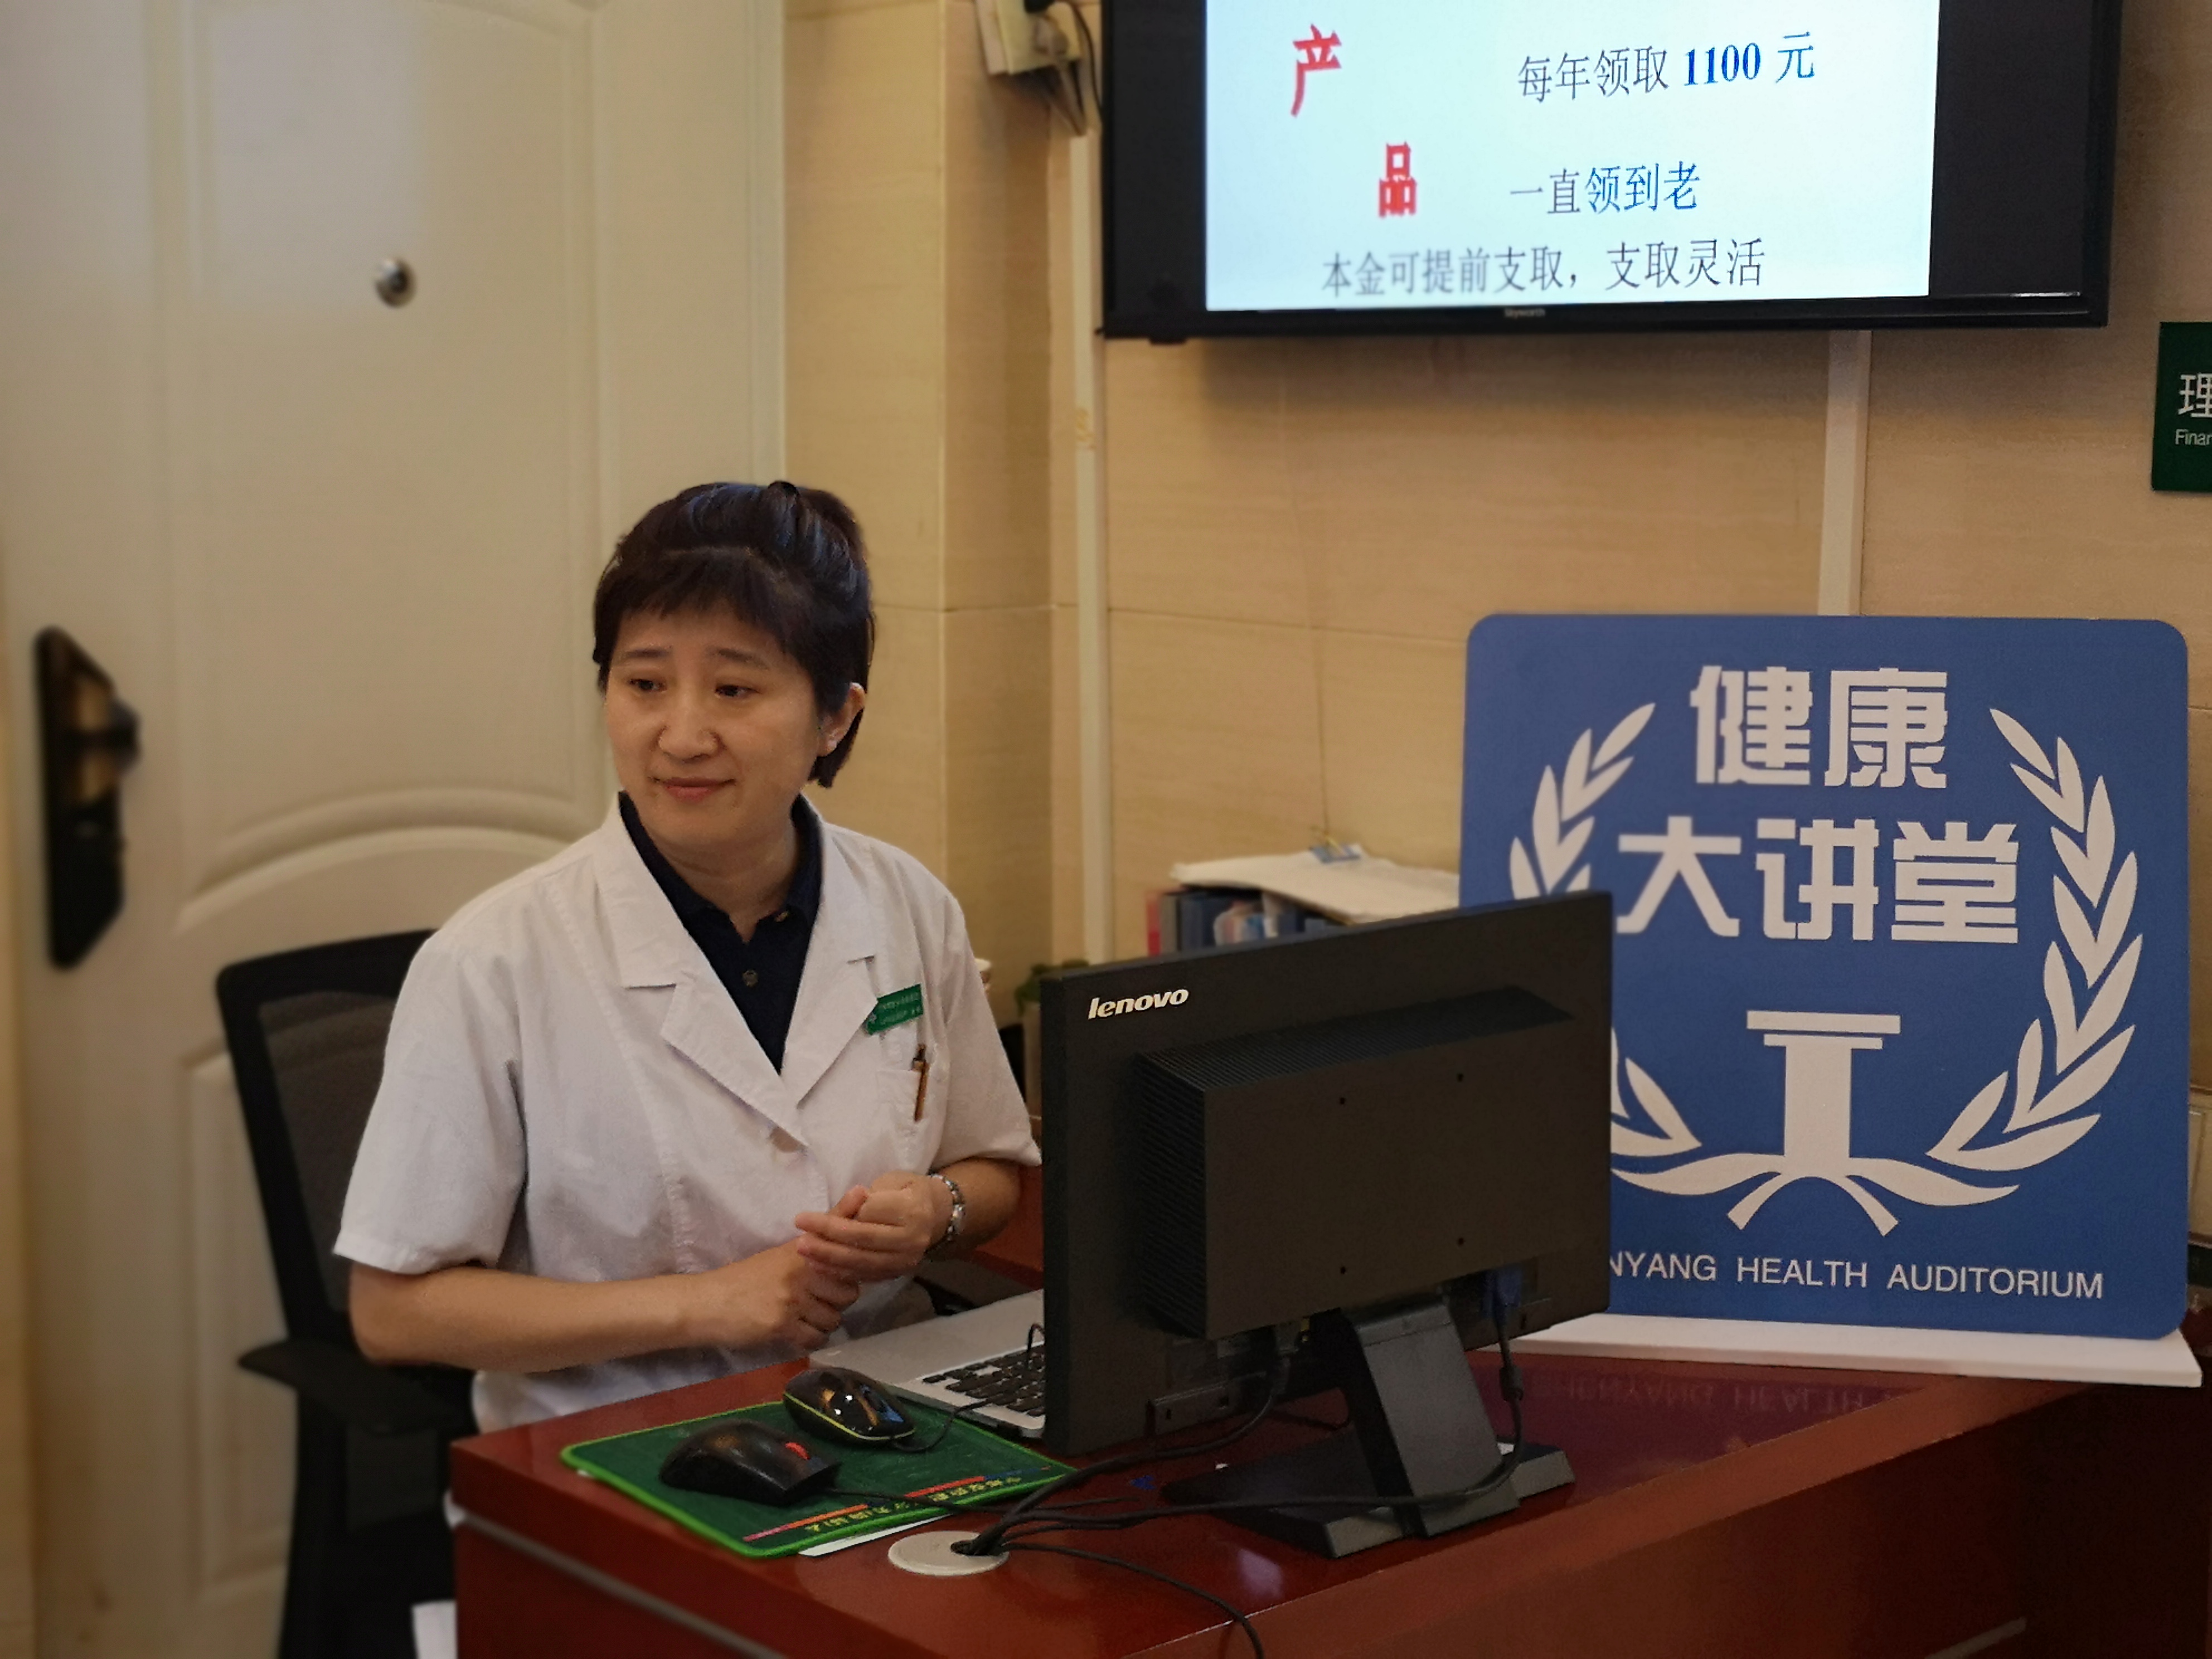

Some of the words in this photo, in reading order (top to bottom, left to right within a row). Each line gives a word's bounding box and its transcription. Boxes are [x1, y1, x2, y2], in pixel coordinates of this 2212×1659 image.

[1290, 23, 1343, 116] 产
[1517, 45, 1670, 103] 每年领取
[1684, 42, 1761, 86] 1100
[1775, 31, 1816, 84] 元
[1378, 143, 1418, 217] 品
[1510, 160, 1701, 215] 一直领到老
[2178, 373, 2212, 418] 理
[1690, 666, 1948, 789] 健康
[1616, 816, 2019, 944] 大讲堂
[1088, 987, 1189, 1020] lenovo
[1737, 1257, 1867, 1288] HEALTH
[1886, 1263, 2103, 1299] AUDITORIUM
